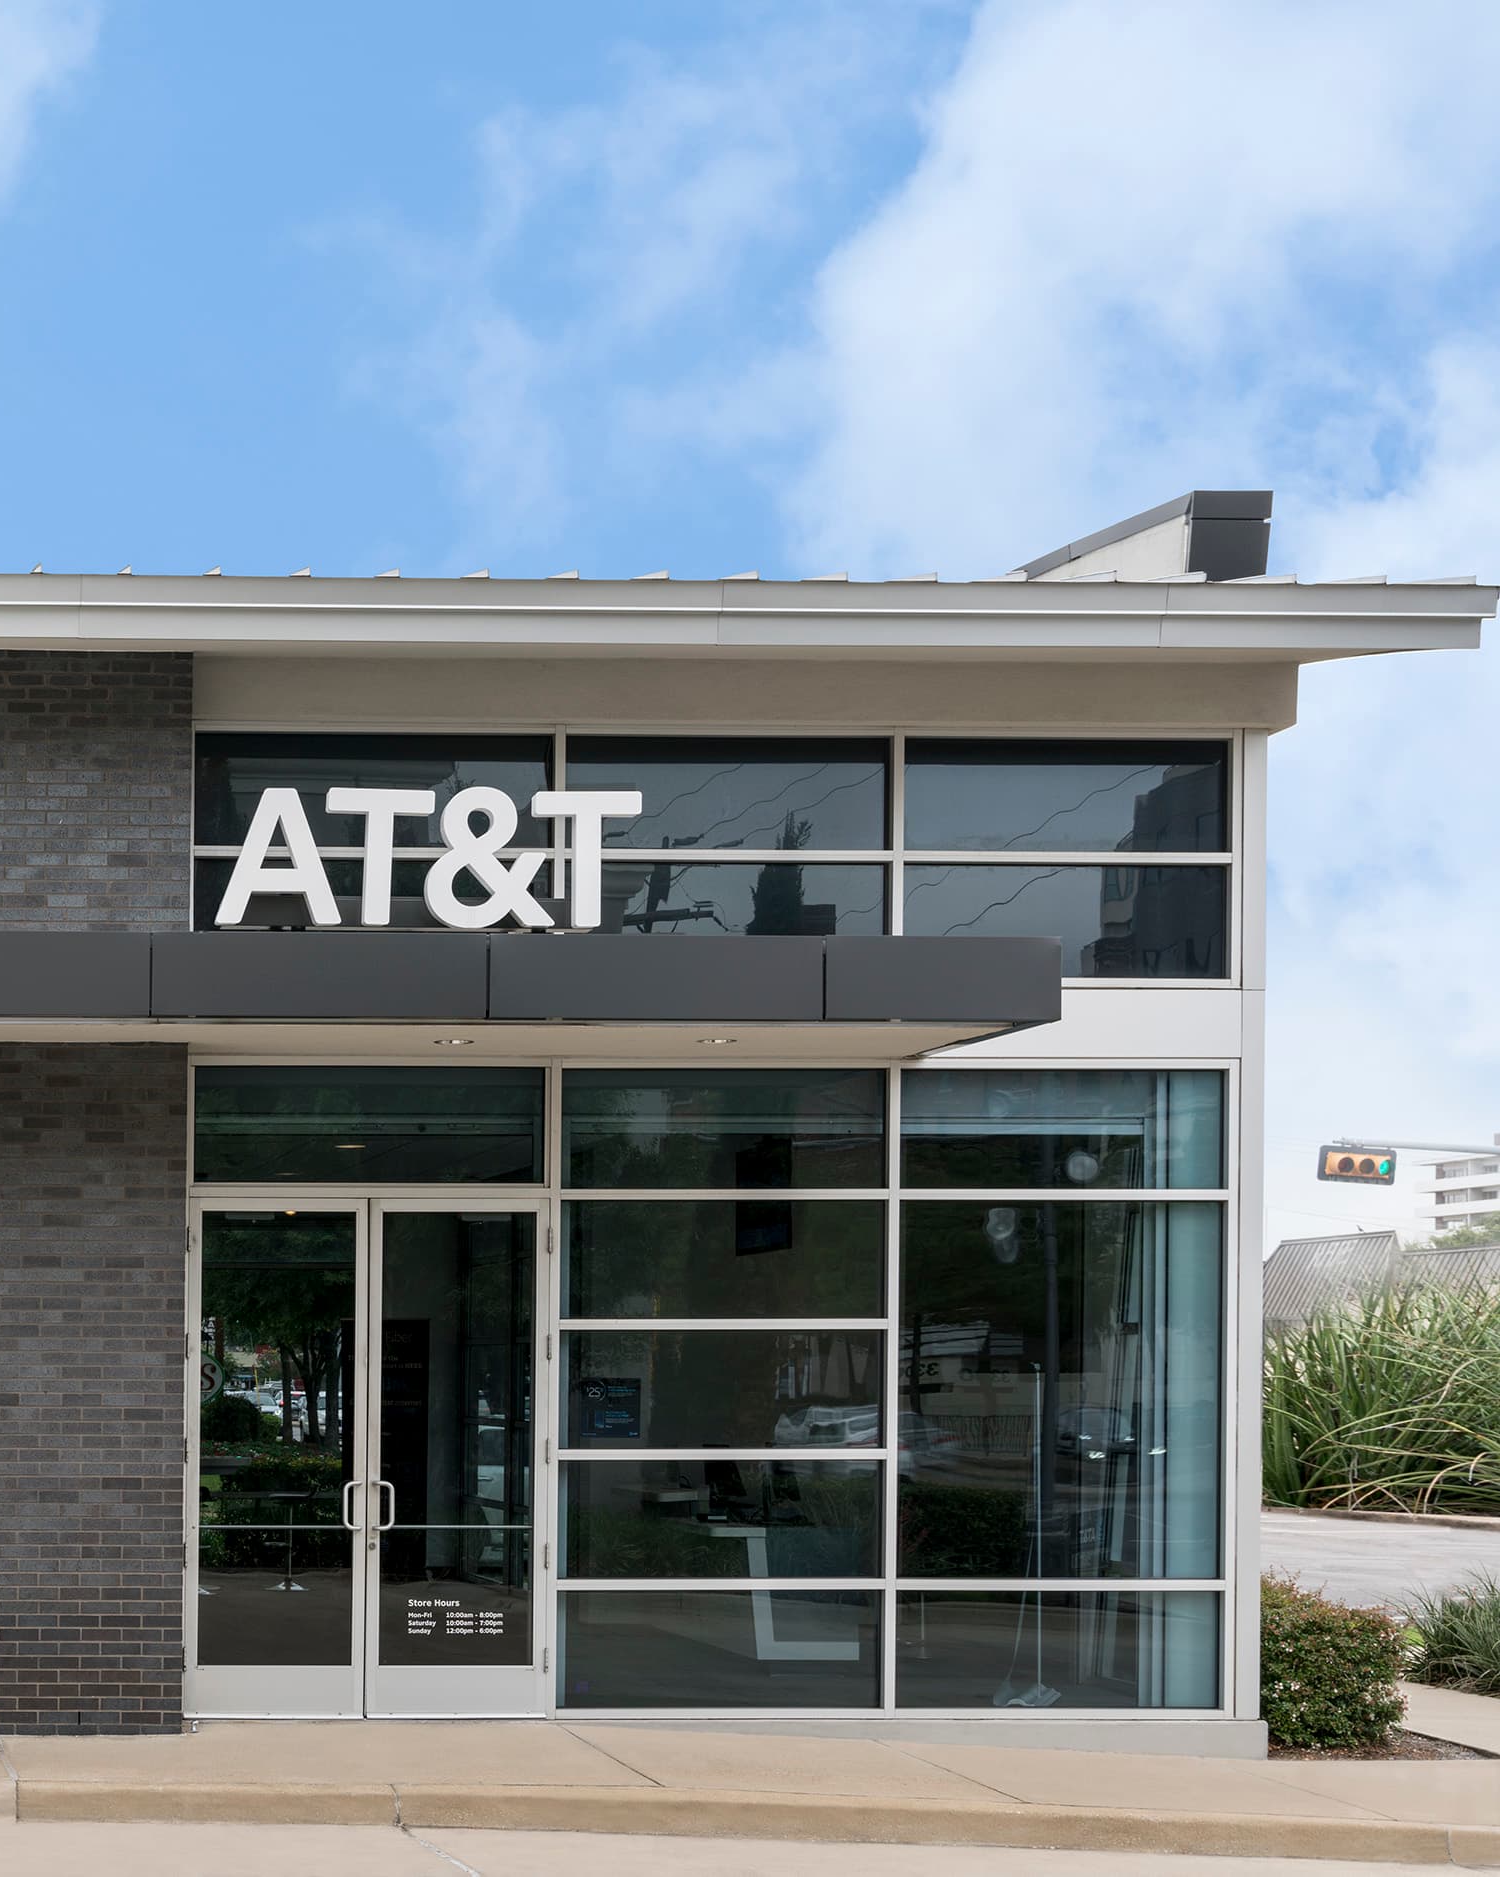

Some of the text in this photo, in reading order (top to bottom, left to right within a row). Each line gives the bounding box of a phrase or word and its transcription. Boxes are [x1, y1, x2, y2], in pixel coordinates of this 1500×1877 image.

[214, 786, 643, 929] AT&T
[407, 1599, 460, 1607] Store Hours
